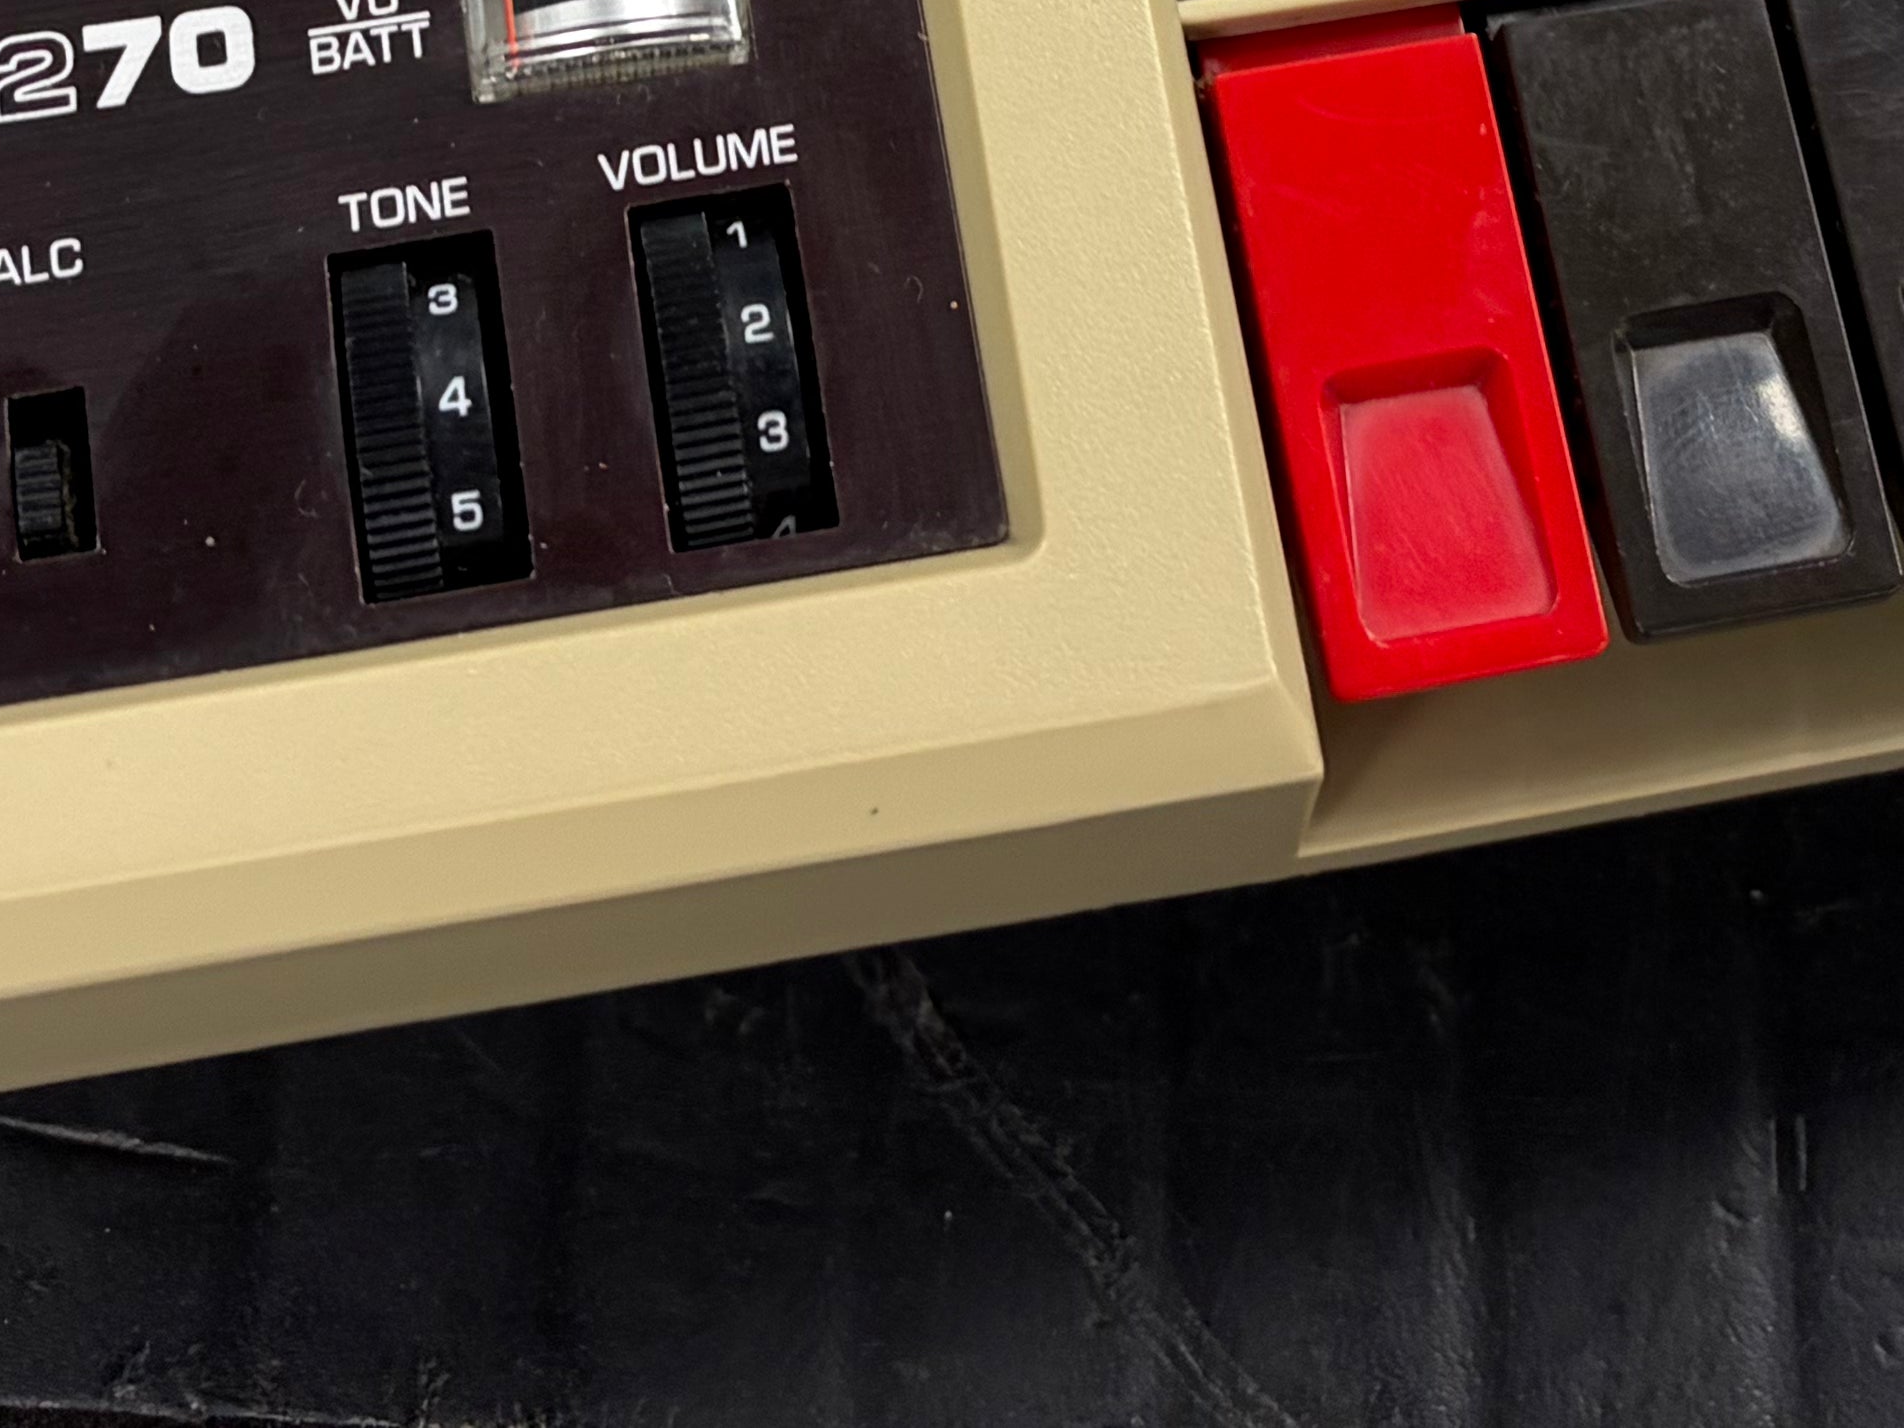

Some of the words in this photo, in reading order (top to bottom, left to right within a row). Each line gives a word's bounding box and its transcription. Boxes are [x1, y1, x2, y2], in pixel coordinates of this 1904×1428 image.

[308, 20, 431, 76] BATT
[597, 123, 799, 191] VOLUME
[337, 176, 471, 232] TONE
[726, 221, 749, 248] 1
[427, 283, 459, 315] 3
[740, 303, 774, 343] 2
[438, 375, 472, 417] 4
[756, 411, 789, 452] 3
[451, 490, 484, 531] 5
